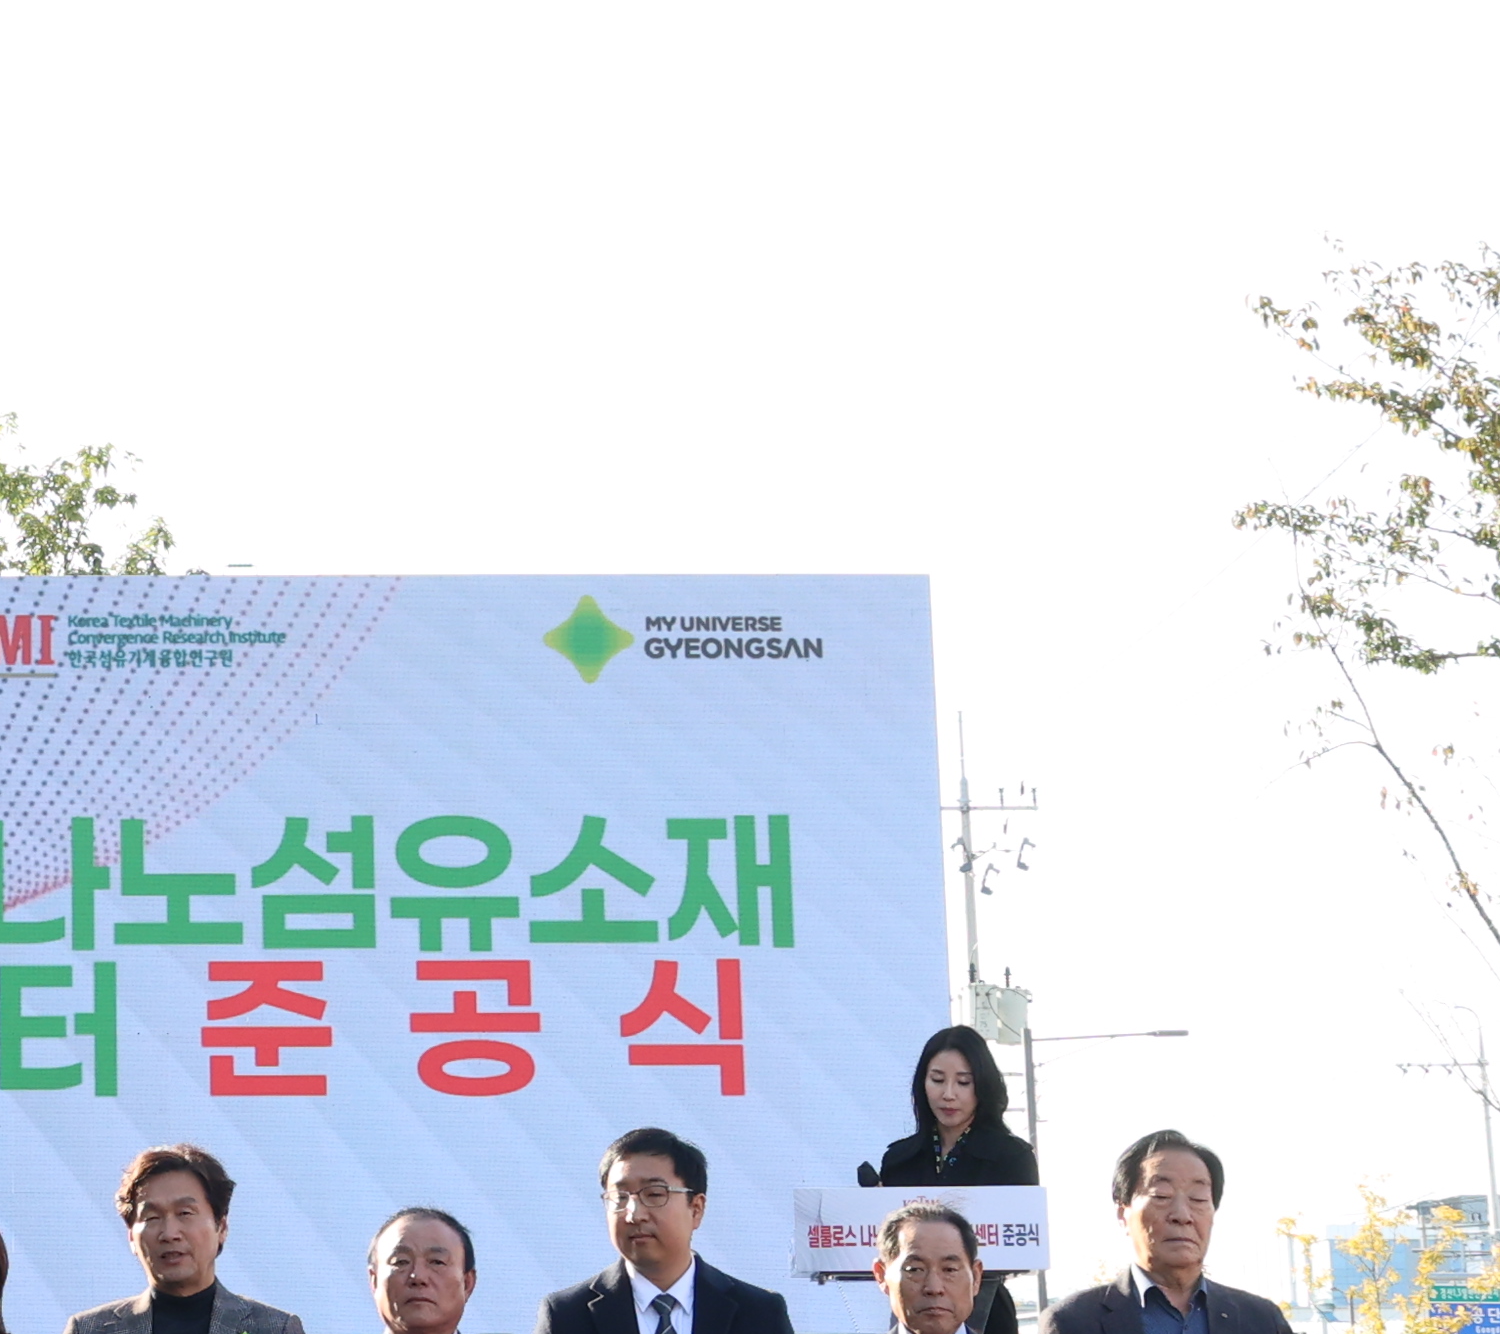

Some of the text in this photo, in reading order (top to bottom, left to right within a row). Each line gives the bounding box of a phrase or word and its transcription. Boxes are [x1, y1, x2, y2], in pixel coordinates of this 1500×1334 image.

[68, 614, 233, 630] Korea Textile Machinery
[645, 615, 783, 632] MY UNIVERSE
[68, 631, 287, 646] Convergence Research Institute
[643, 637, 824, 659] GYEONGSAN
[67, 649, 234, 668] 한국섬유기계융합연구원
[807, 1224, 858, 1249] 셀룰로스
[1002, 1223, 1040, 1247] 준공식
